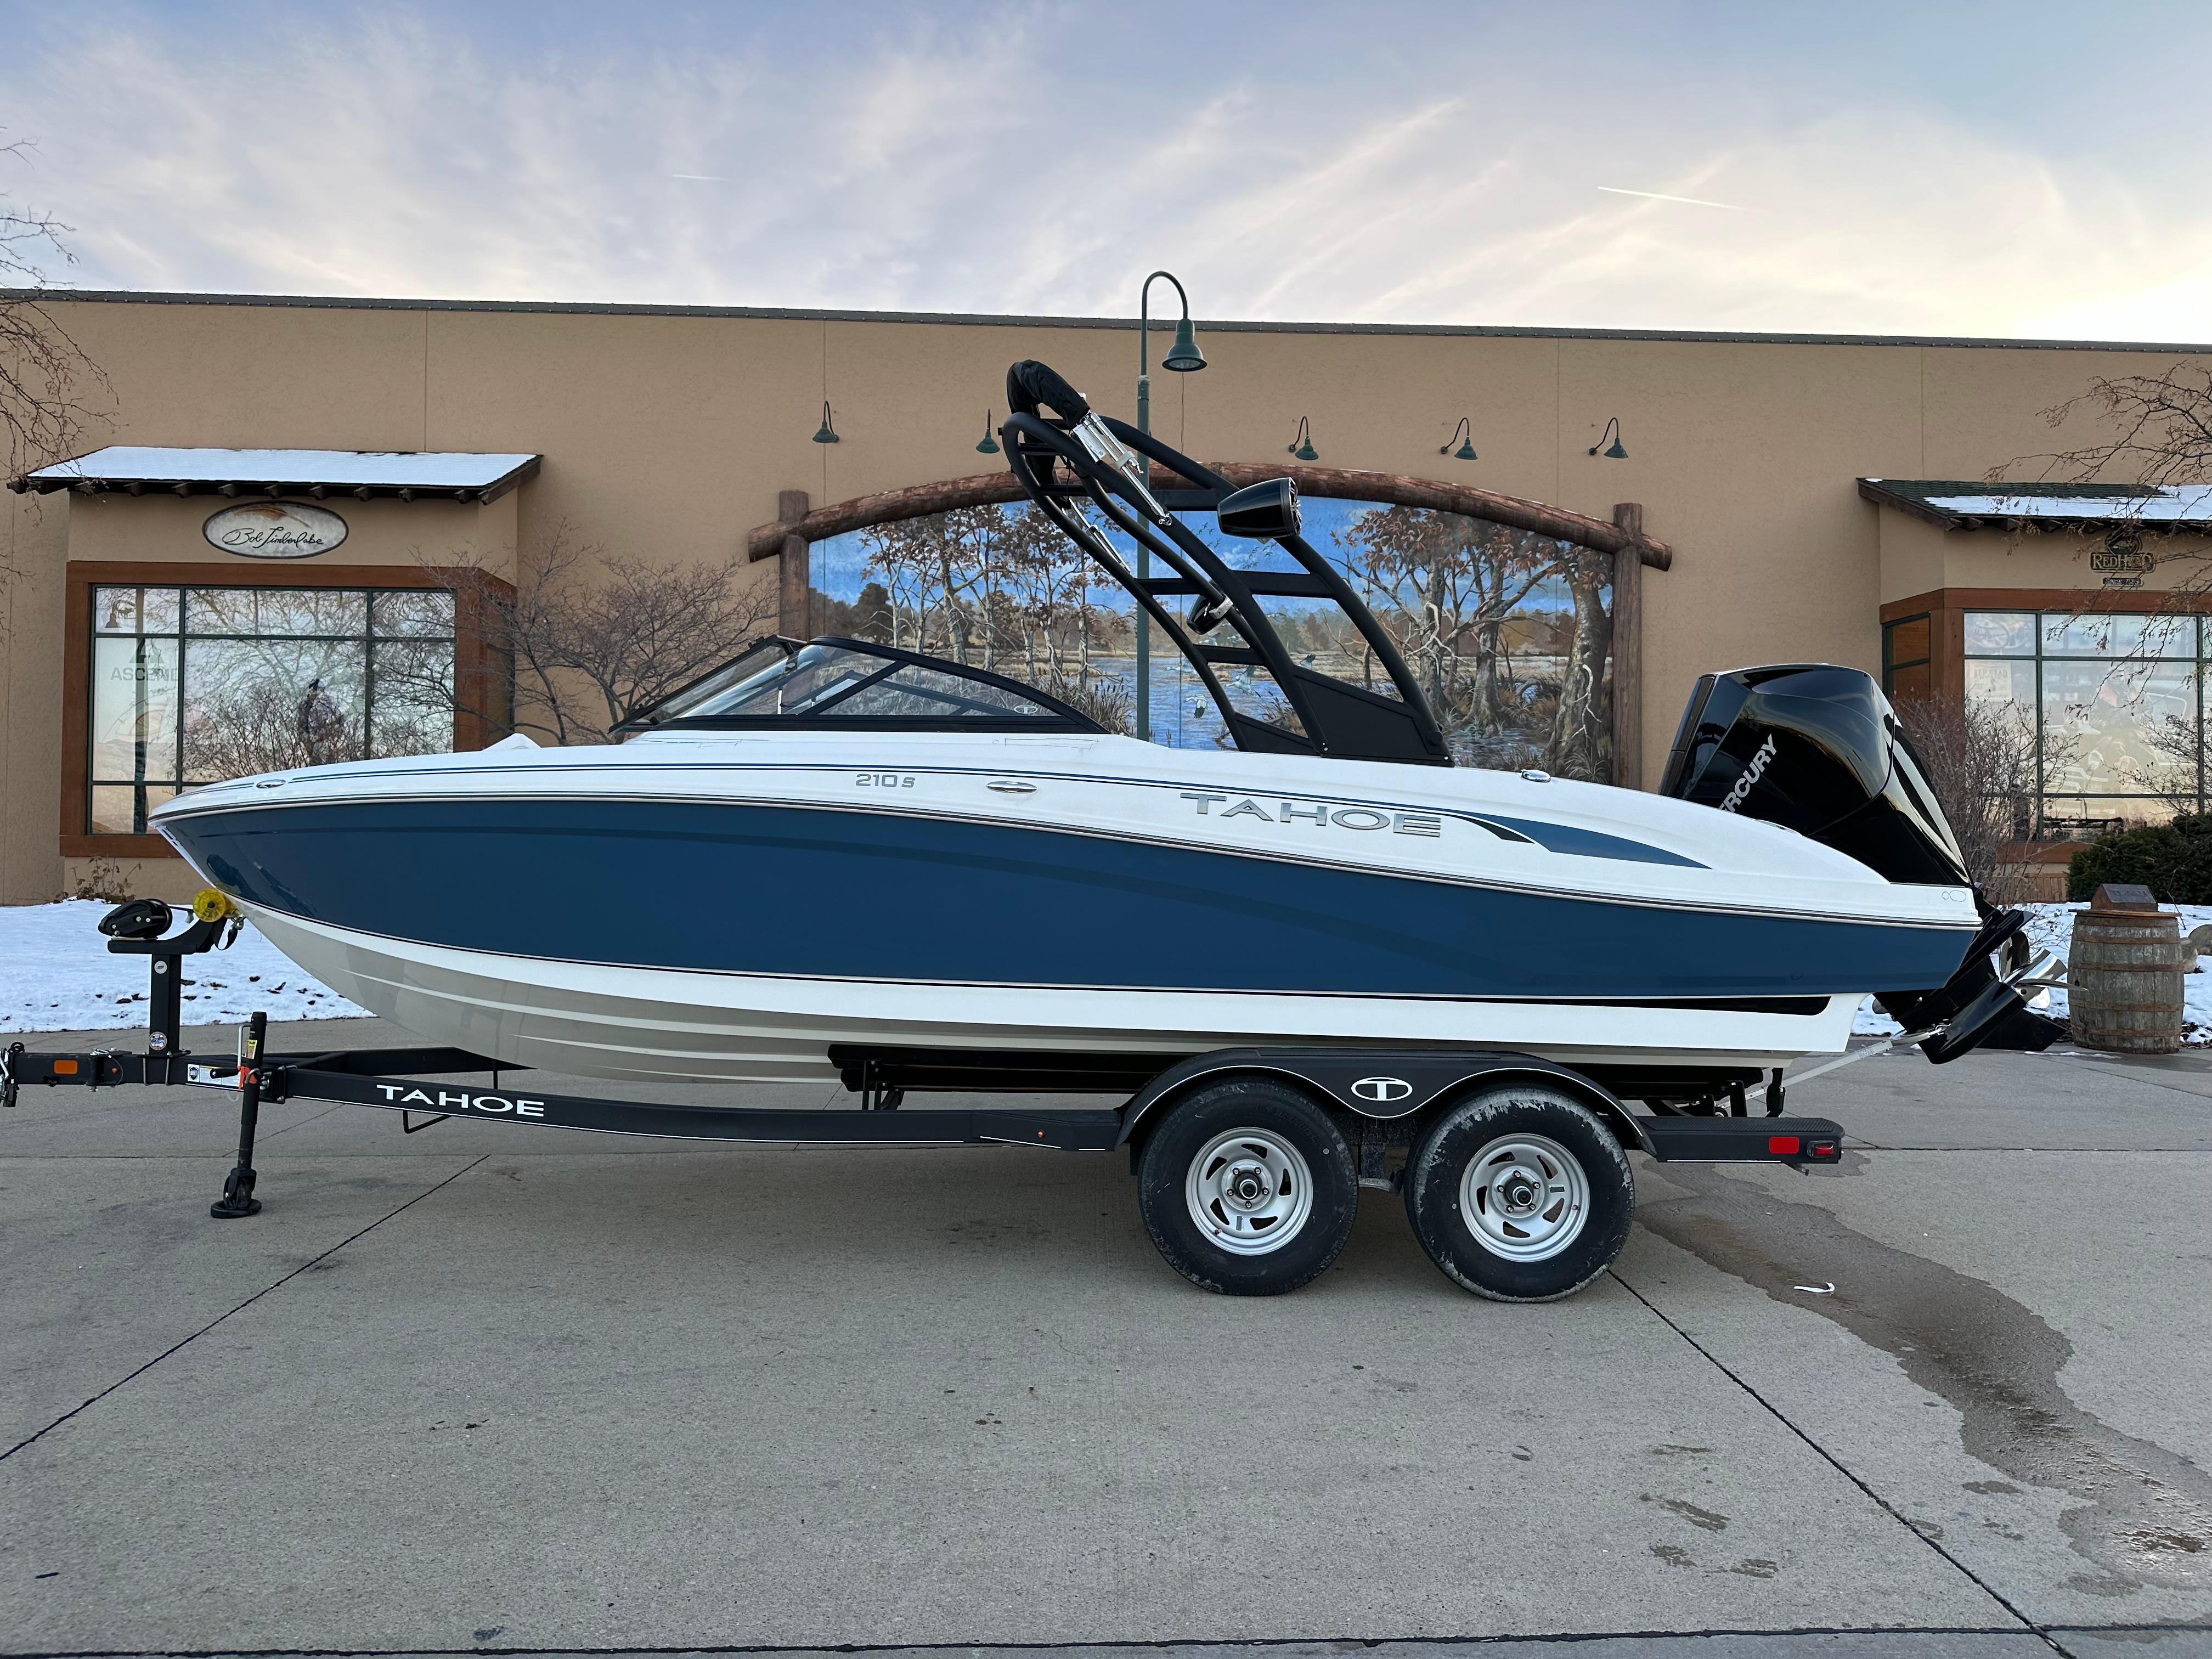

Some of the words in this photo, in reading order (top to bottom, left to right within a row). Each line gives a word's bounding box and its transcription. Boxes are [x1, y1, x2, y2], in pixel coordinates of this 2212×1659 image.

[222, 528, 263, 545] Bob
[252, 526, 324, 548] Timberlake
[856, 774, 898, 787] 210
[1180, 793, 1441, 837] TAHOE
[376, 1085, 544, 1117] TAHOE
